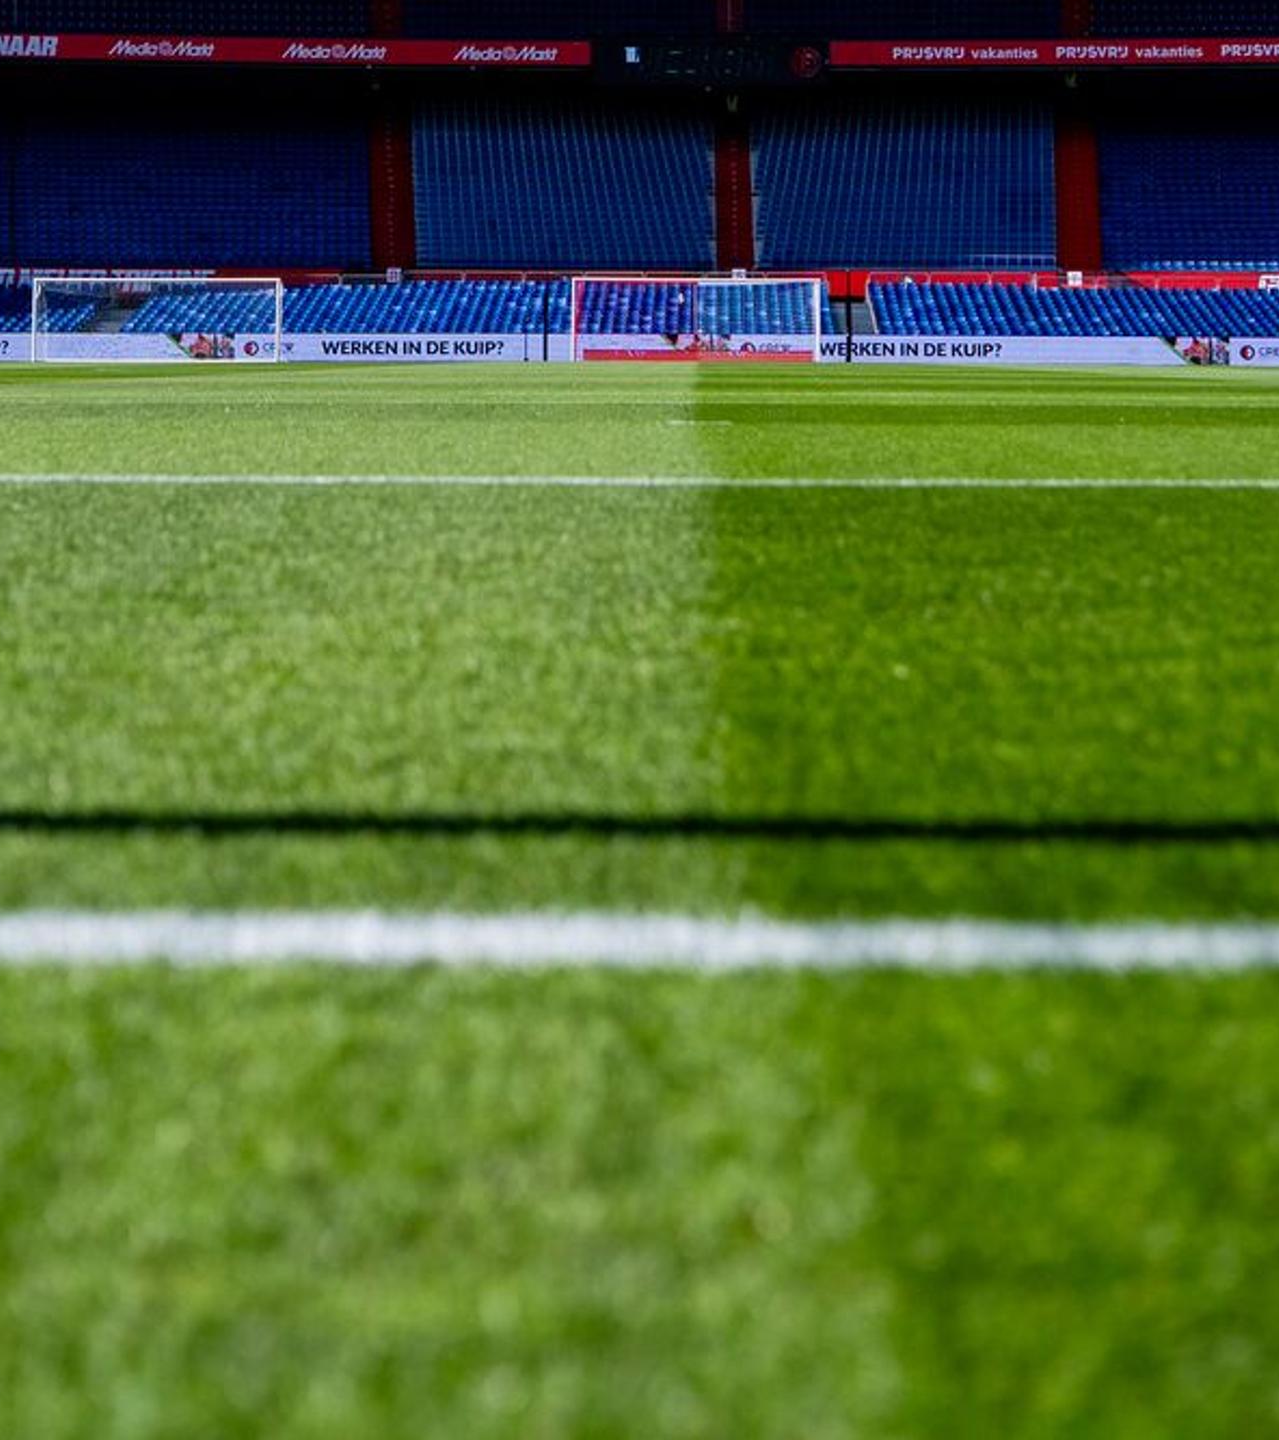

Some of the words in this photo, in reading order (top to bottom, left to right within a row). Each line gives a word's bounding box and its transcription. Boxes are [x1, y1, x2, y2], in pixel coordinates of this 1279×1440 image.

[970, 46, 1039, 60] vakanties
[1134, 45, 1204, 59] vakanties
[322, 341, 399, 356] WERKEN
[403, 341, 423, 355] IN
[426, 341, 450, 355] DE
[453, 341, 505, 356] KUIP?
[820, 342, 895, 357] WERKEN
[900, 343, 920, 357] IN
[923, 343, 947, 357] DE
[951, 343, 1003, 358] KUIP?
